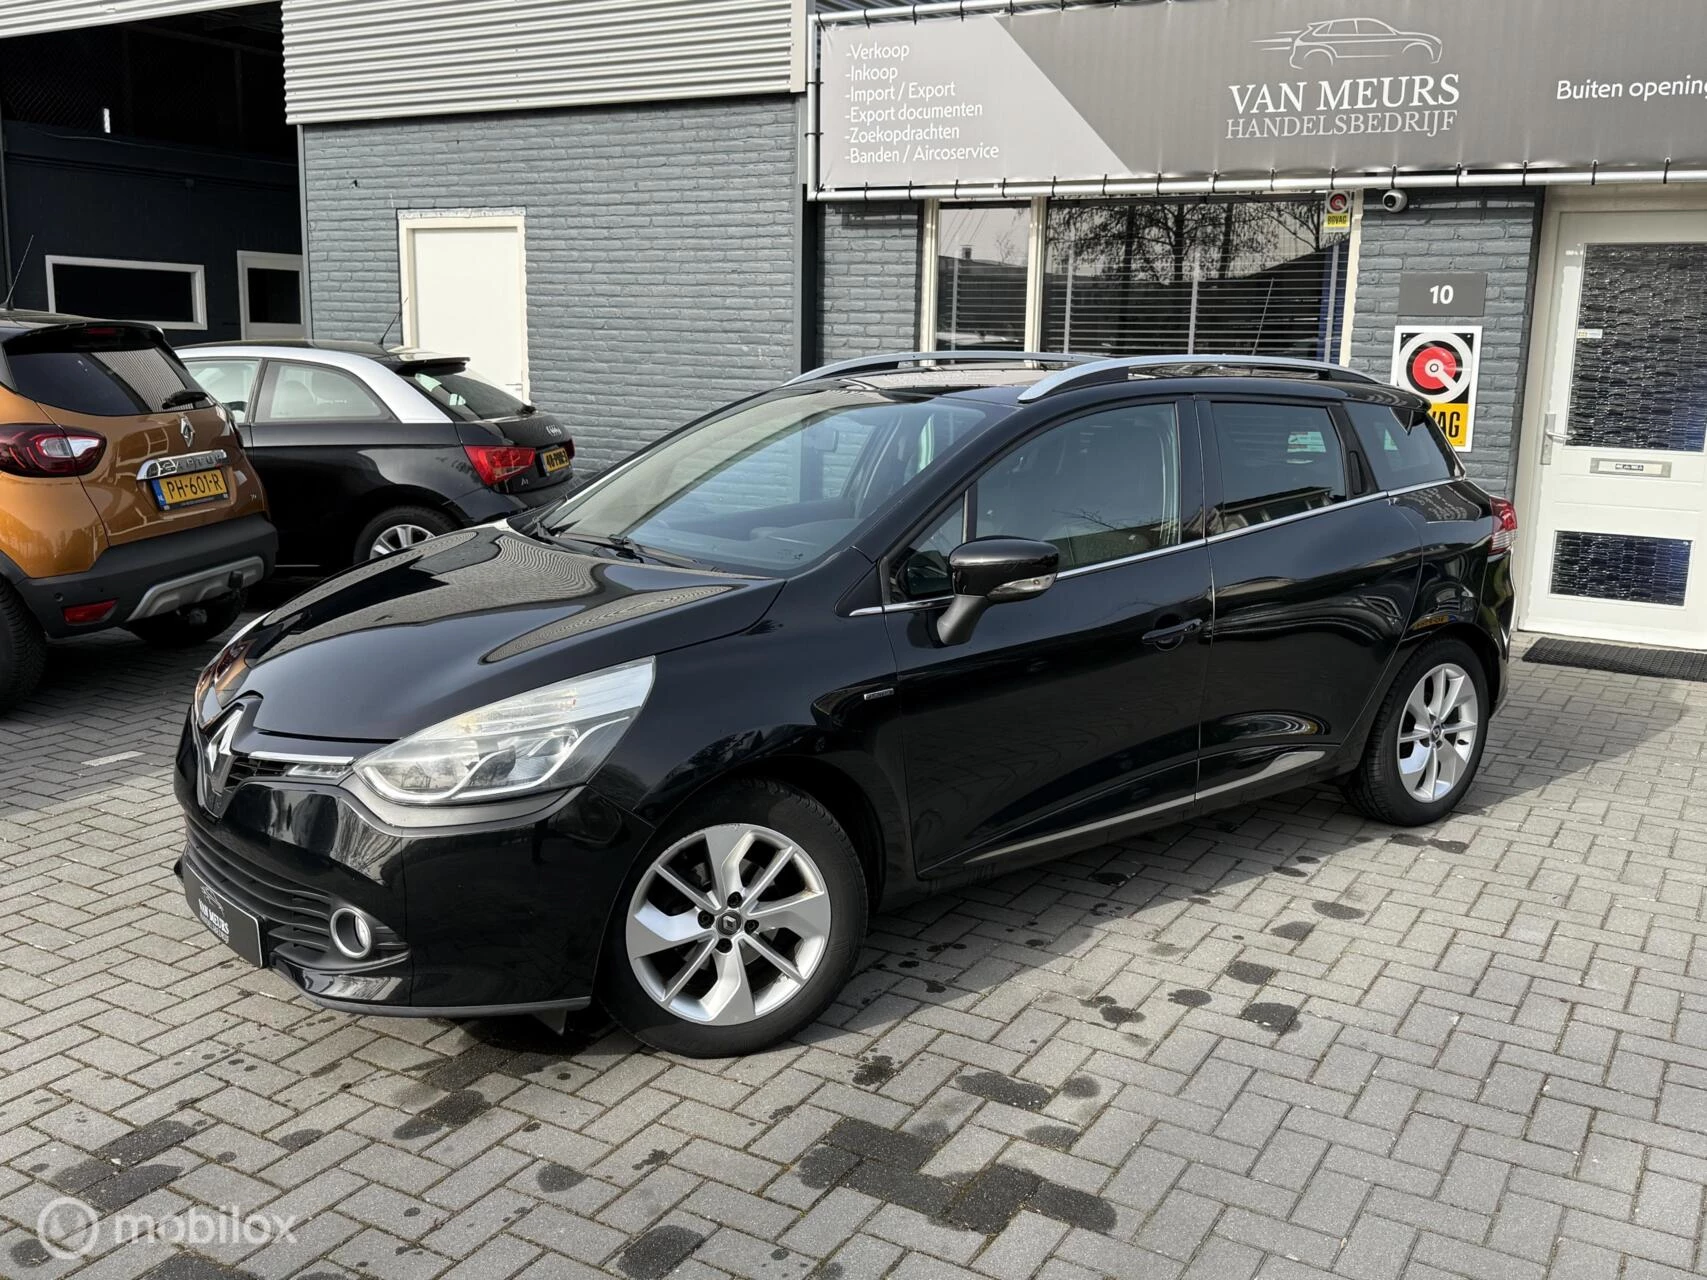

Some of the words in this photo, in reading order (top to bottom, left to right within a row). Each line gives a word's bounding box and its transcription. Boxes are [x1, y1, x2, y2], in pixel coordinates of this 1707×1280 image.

[908, 80, 956, 102] Export
[1228, 81, 1308, 114] VAN
[1316, 73, 1460, 111] MEURS
[1556, 79, 1623, 100] Buiten
[1629, 74, 1707, 102] openin
[898, 103, 983, 120] documenten
[1225, 109, 1458, 139] HANDELSBEDRIJF
[913, 142, 1000, 161] Aircoservice
[1430, 285, 1454, 304] 10
[166, 473, 223, 500] PH-601-R
